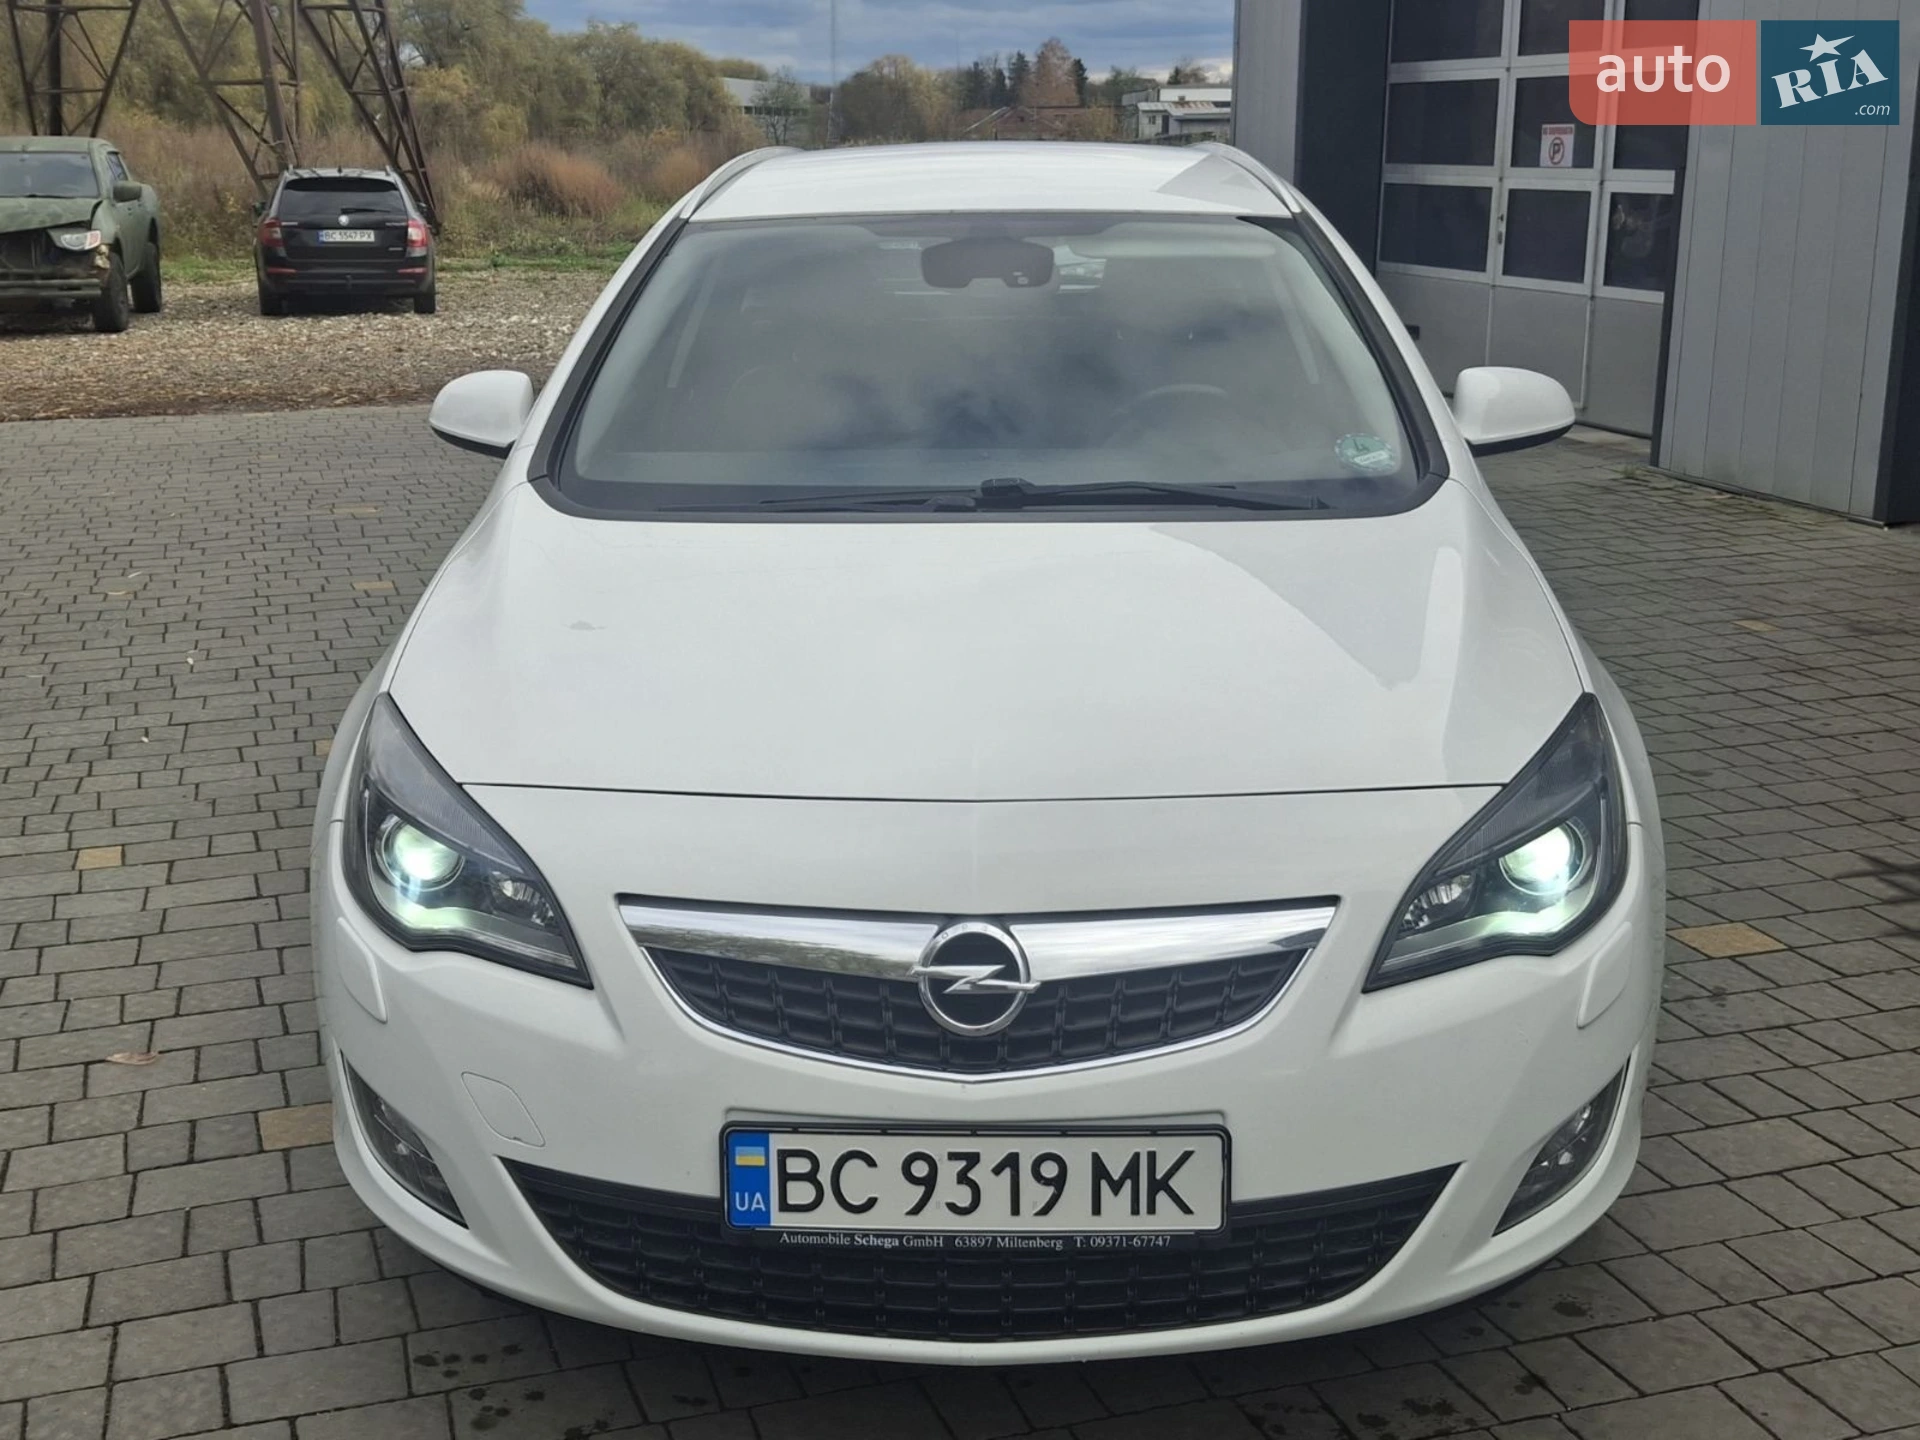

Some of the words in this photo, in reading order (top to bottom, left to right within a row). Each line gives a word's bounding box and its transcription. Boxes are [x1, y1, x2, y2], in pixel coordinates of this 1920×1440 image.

[777, 1149, 879, 1214] BC
[901, 1151, 1068, 1216] 9319
[1091, 1150, 1196, 1216] MK
[735, 1191, 766, 1212] UA
[779, 1232, 851, 1246] Automobile
[853, 1233, 900, 1249] Schega
[902, 1235, 944, 1247] GmbH
[954, 1236, 992, 1247] 63897
[996, 1236, 1064, 1250] Miltenberg
[1090, 1236, 1171, 1247] 09371-67747
